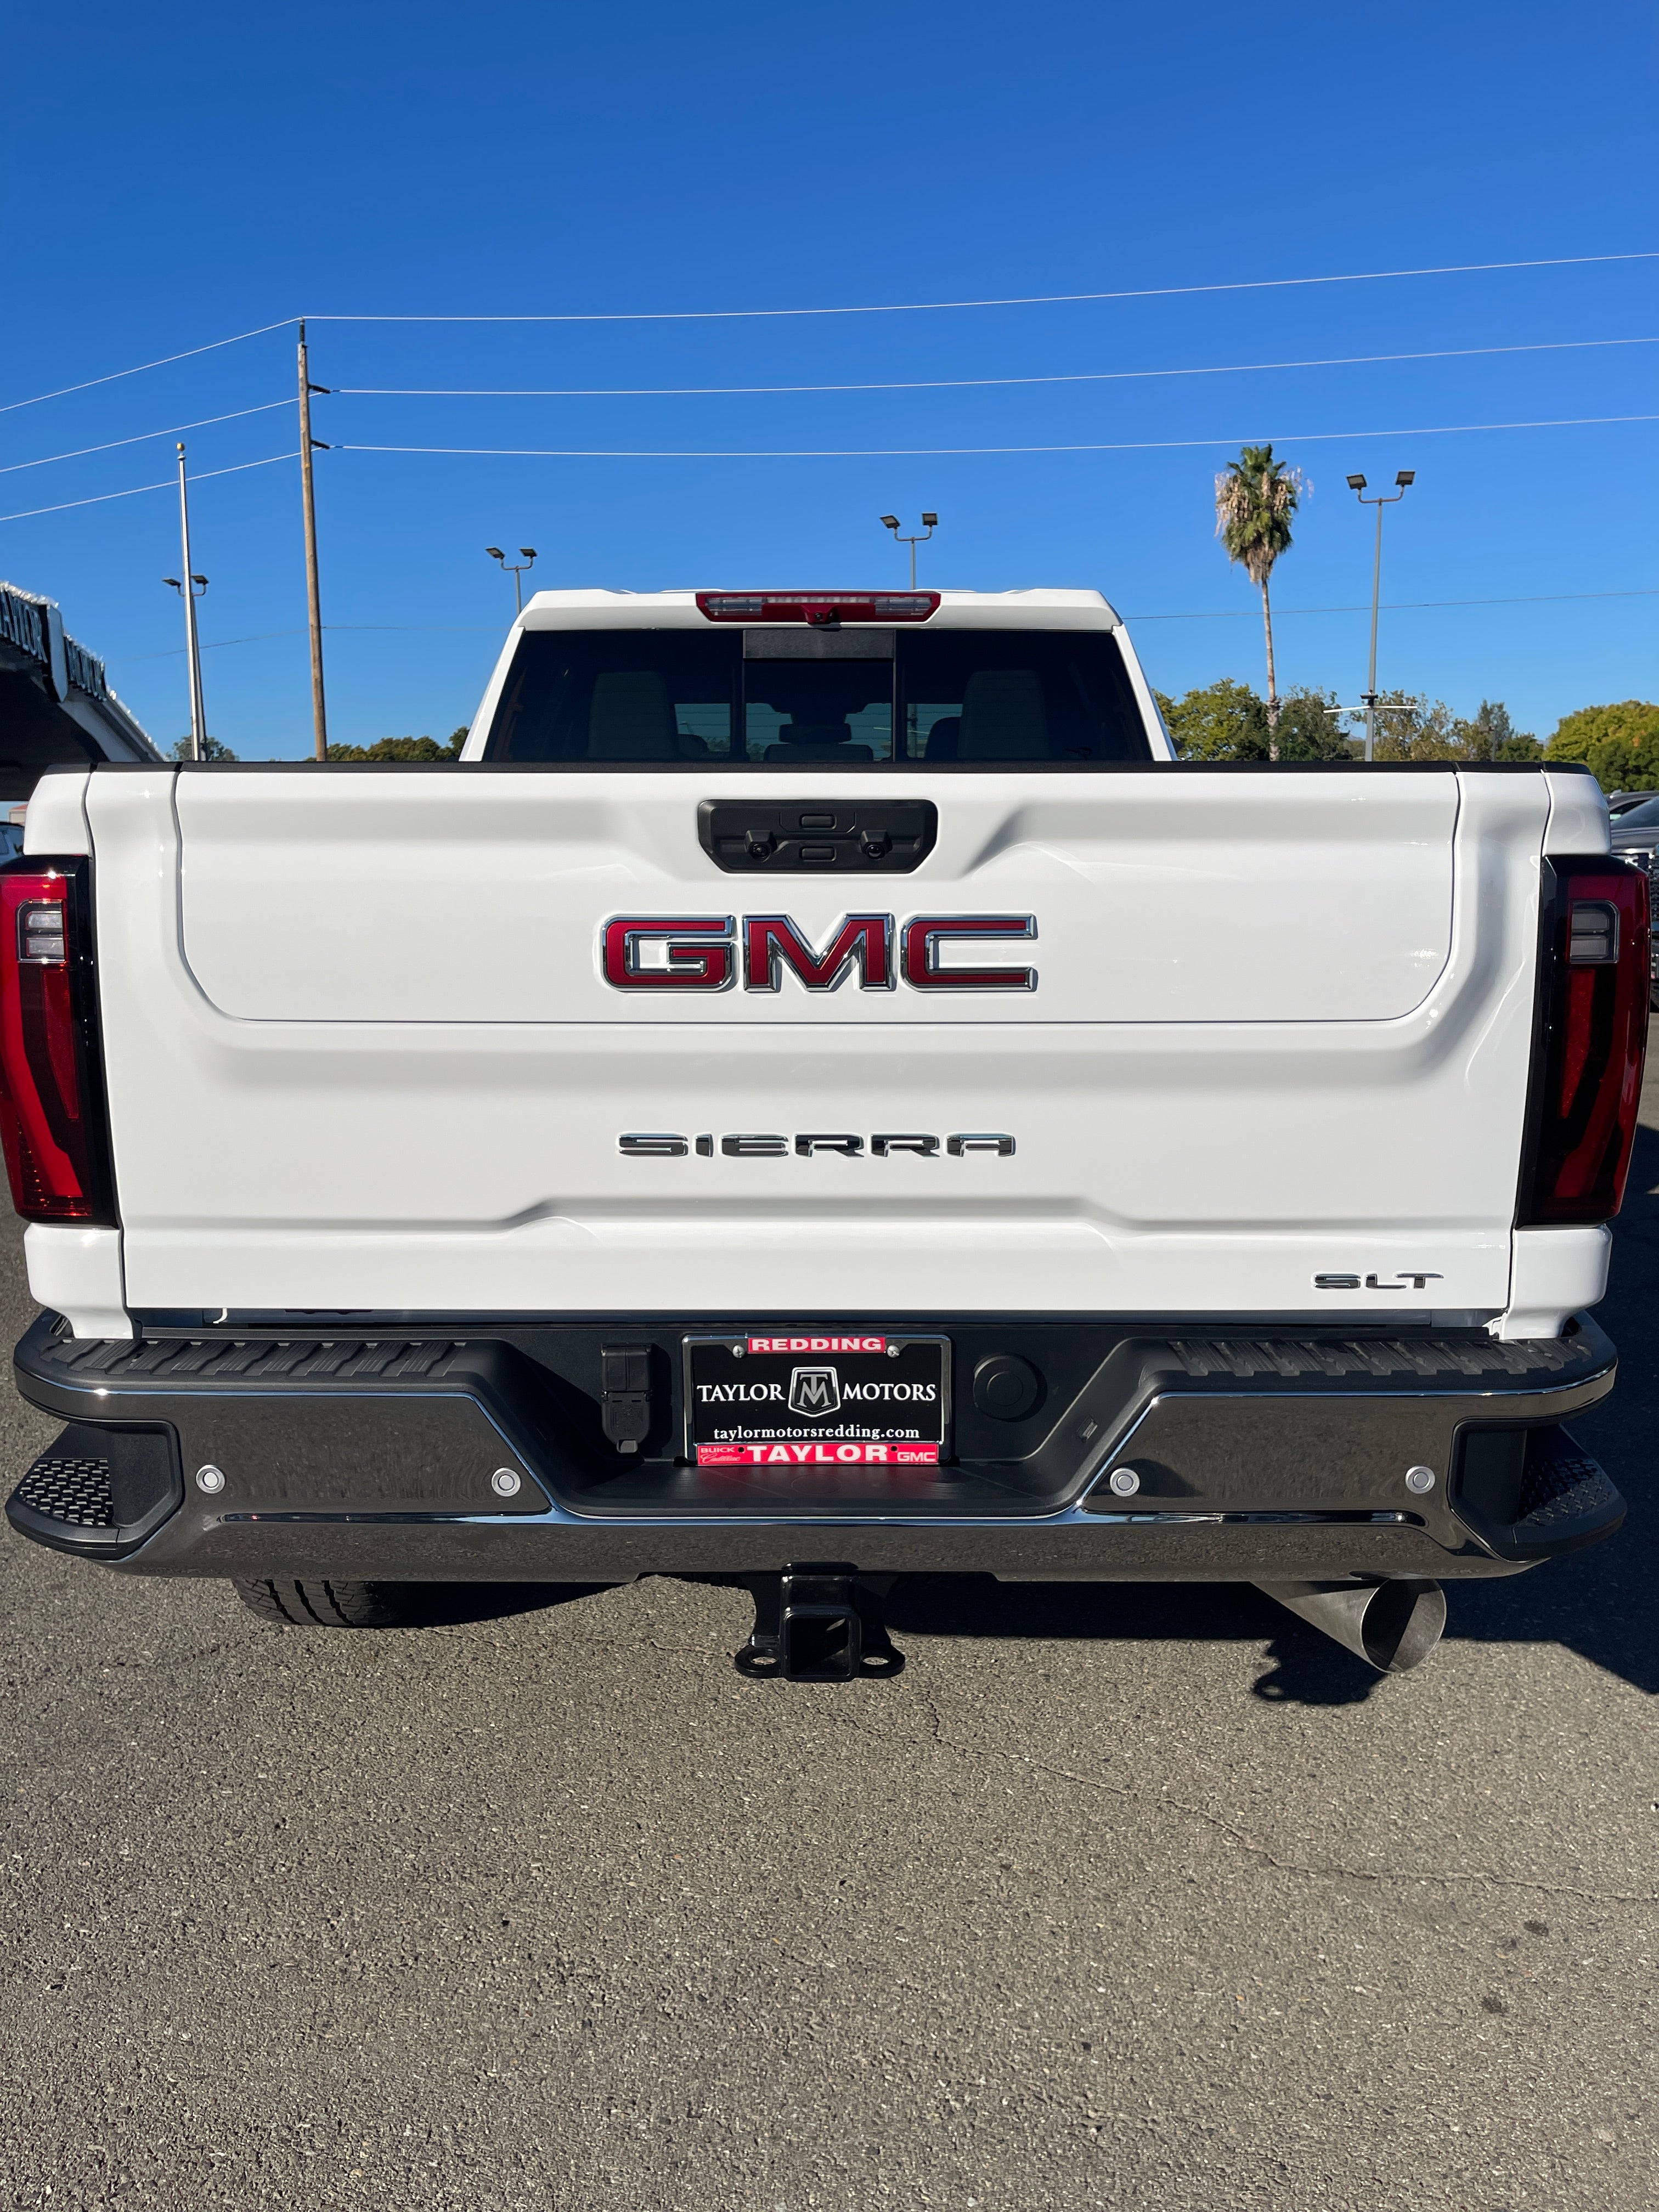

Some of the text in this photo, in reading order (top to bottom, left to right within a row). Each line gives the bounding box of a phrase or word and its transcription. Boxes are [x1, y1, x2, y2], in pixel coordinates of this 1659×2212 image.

[601, 913, 1036, 992] GMC
[618, 1133, 1016, 1158] SIERRA
[1314, 1273, 1444, 1289] SLT
[752, 1338, 881, 1351] REDDING
[697, 1383, 936, 1402] TAYLOR MOTORS
[714, 1425, 920, 1441] taylormotorsredding.com
[747, 1445, 888, 1462] TAYLOR
[898, 1452, 936, 1462] GMC
